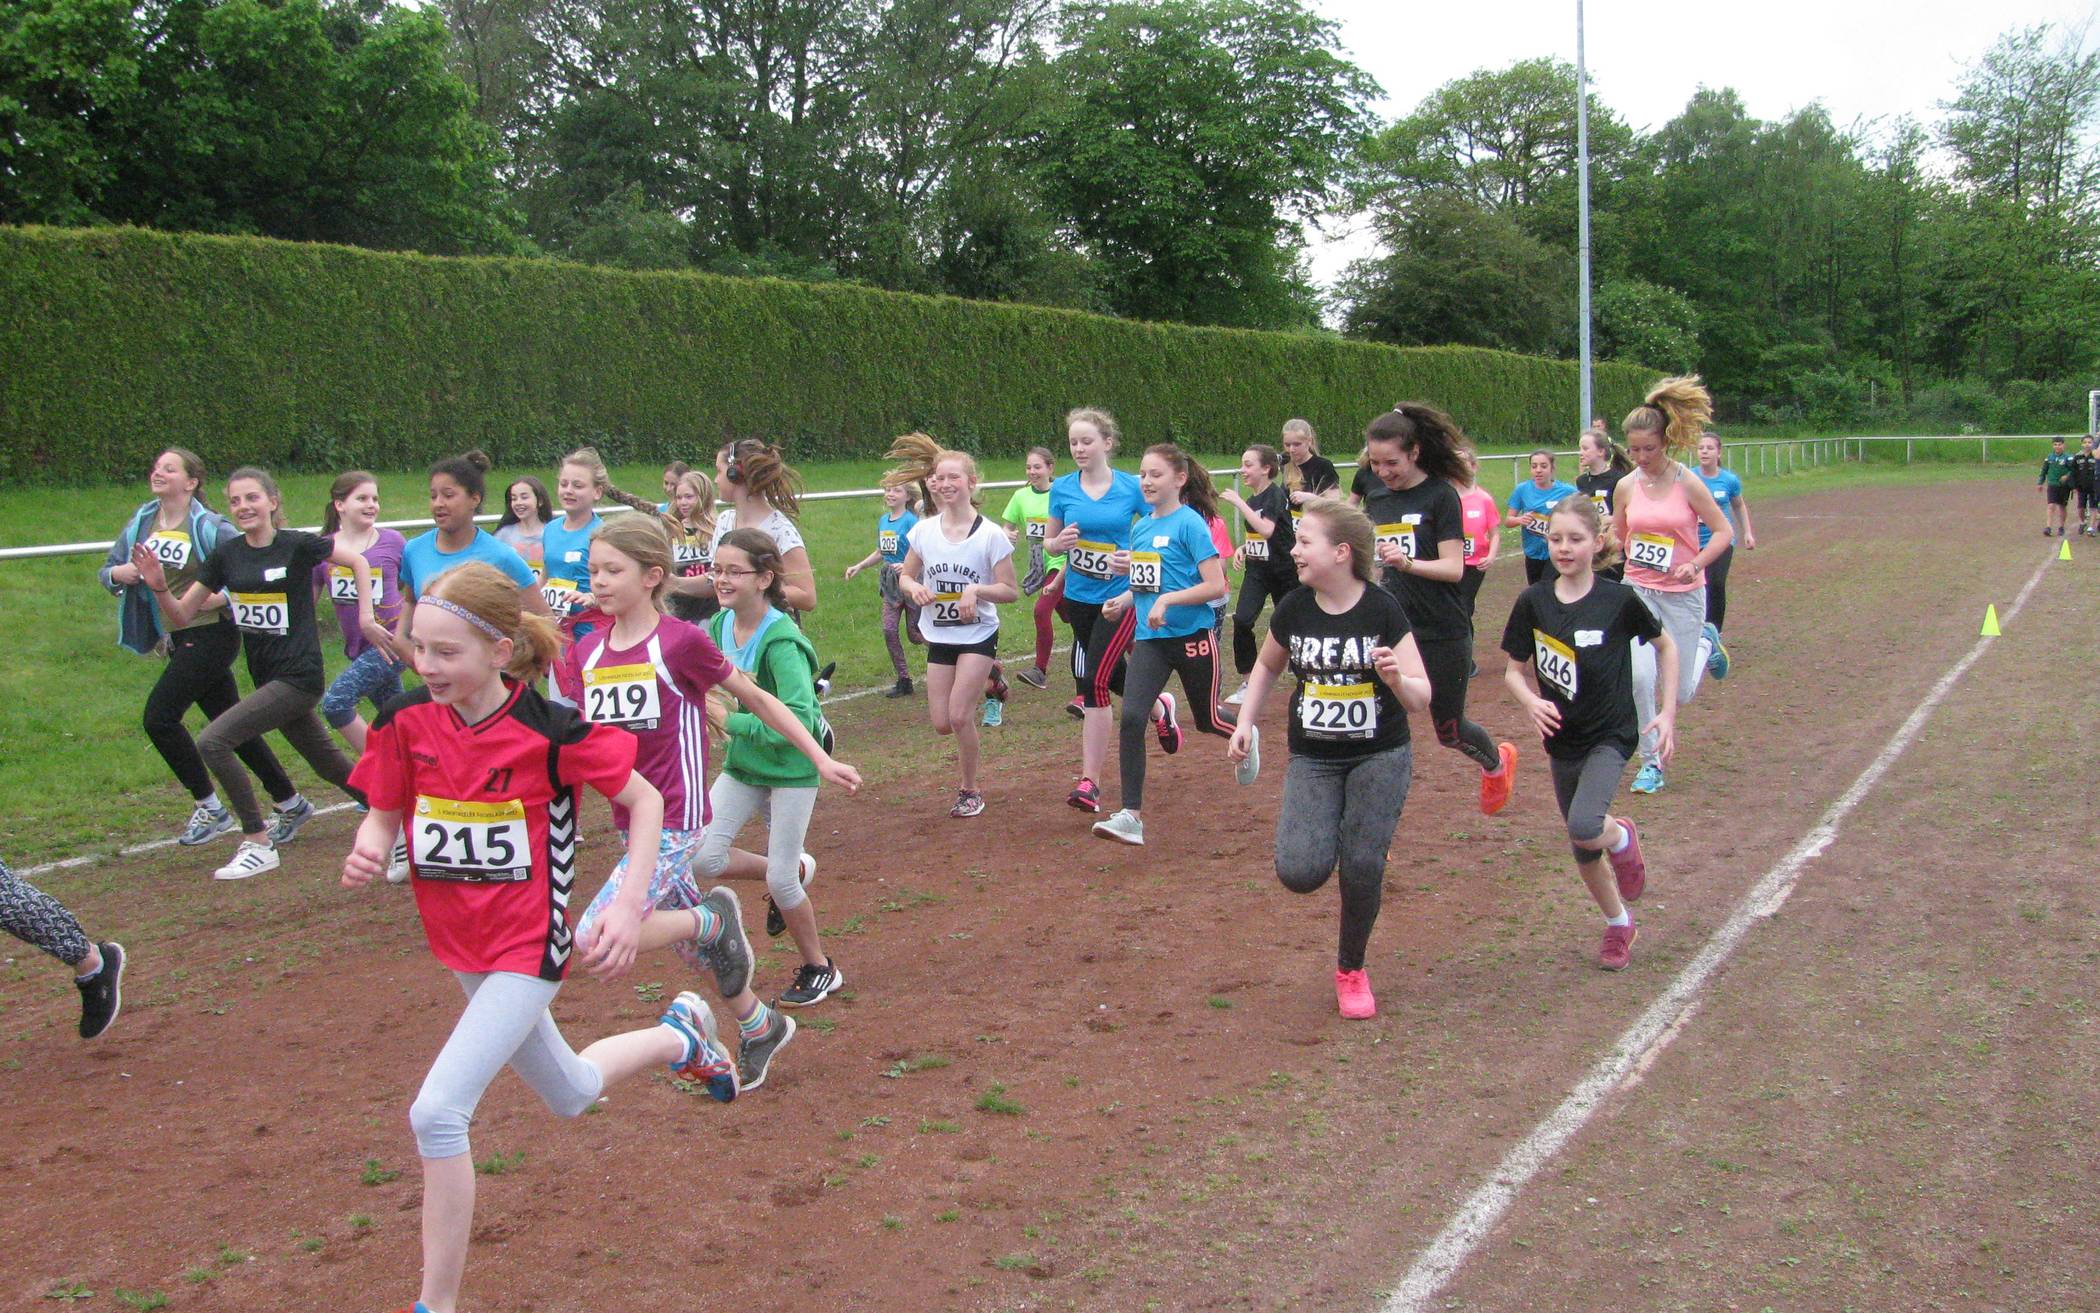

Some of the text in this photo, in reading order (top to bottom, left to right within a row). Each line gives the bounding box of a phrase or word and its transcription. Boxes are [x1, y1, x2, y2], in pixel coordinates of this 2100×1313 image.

[1030, 523, 1046, 536] 21
[150, 540, 183, 561] 266
[882, 537, 895, 550] 205
[1634, 543, 1667, 564] 259
[1073, 548, 1108, 572] 256
[953, 563, 981, 584] VIBES
[1131, 563, 1155, 584] 233
[239, 604, 282, 627] 250
[935, 603, 960, 620] 26
[1185, 640, 1210, 658] 58
[1540, 646, 1571, 686] 246
[590, 683, 648, 721] 219
[1309, 699, 1368, 729] 220
[484, 767, 513, 793] 27
[424, 822, 516, 867] 215
